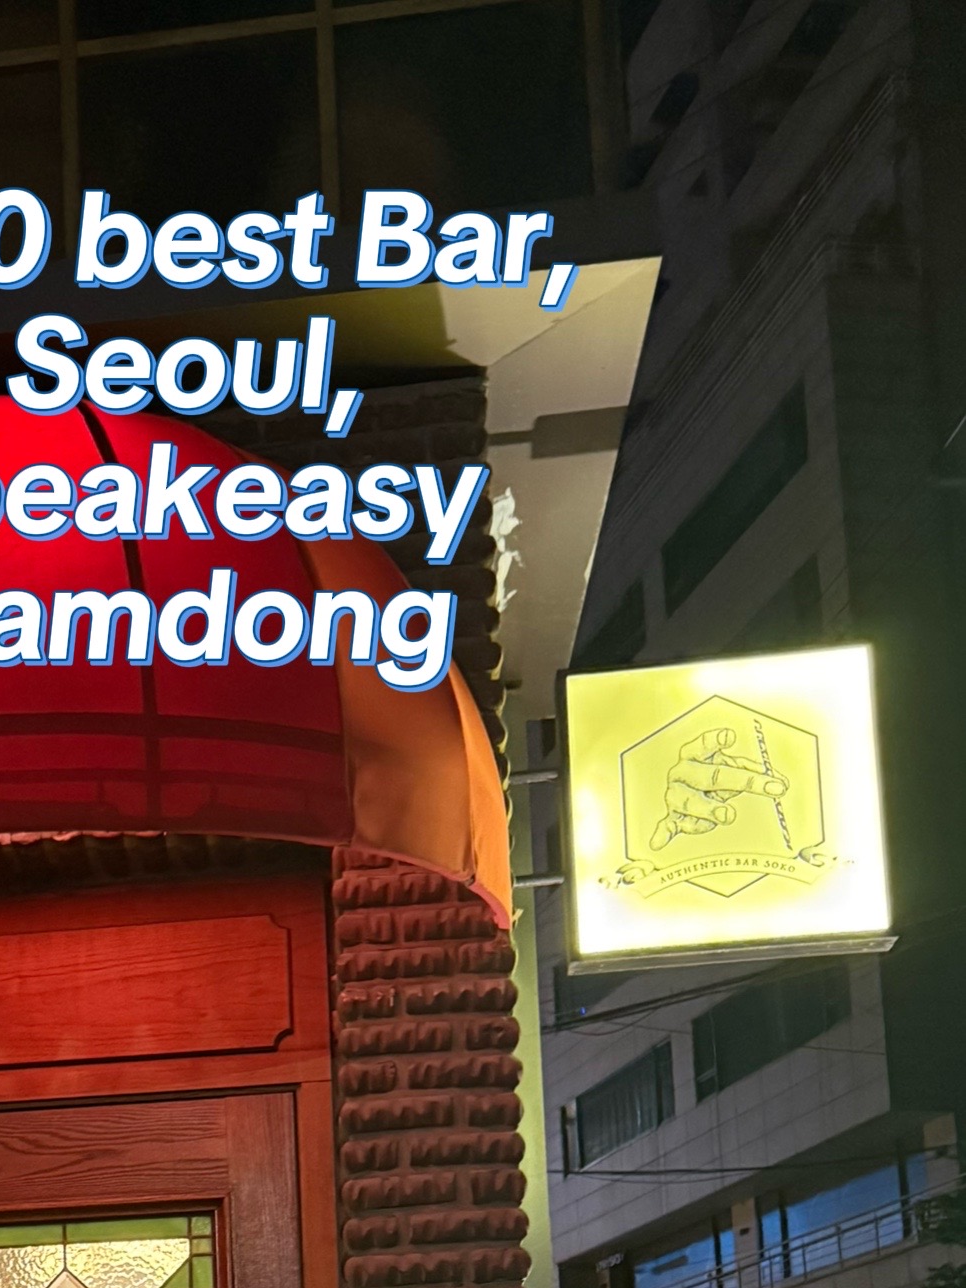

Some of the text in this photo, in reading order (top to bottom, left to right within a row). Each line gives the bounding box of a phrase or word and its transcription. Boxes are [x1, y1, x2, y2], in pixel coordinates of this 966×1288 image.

[660, 857, 797, 885] AUTHENTIC BAR SOKO
